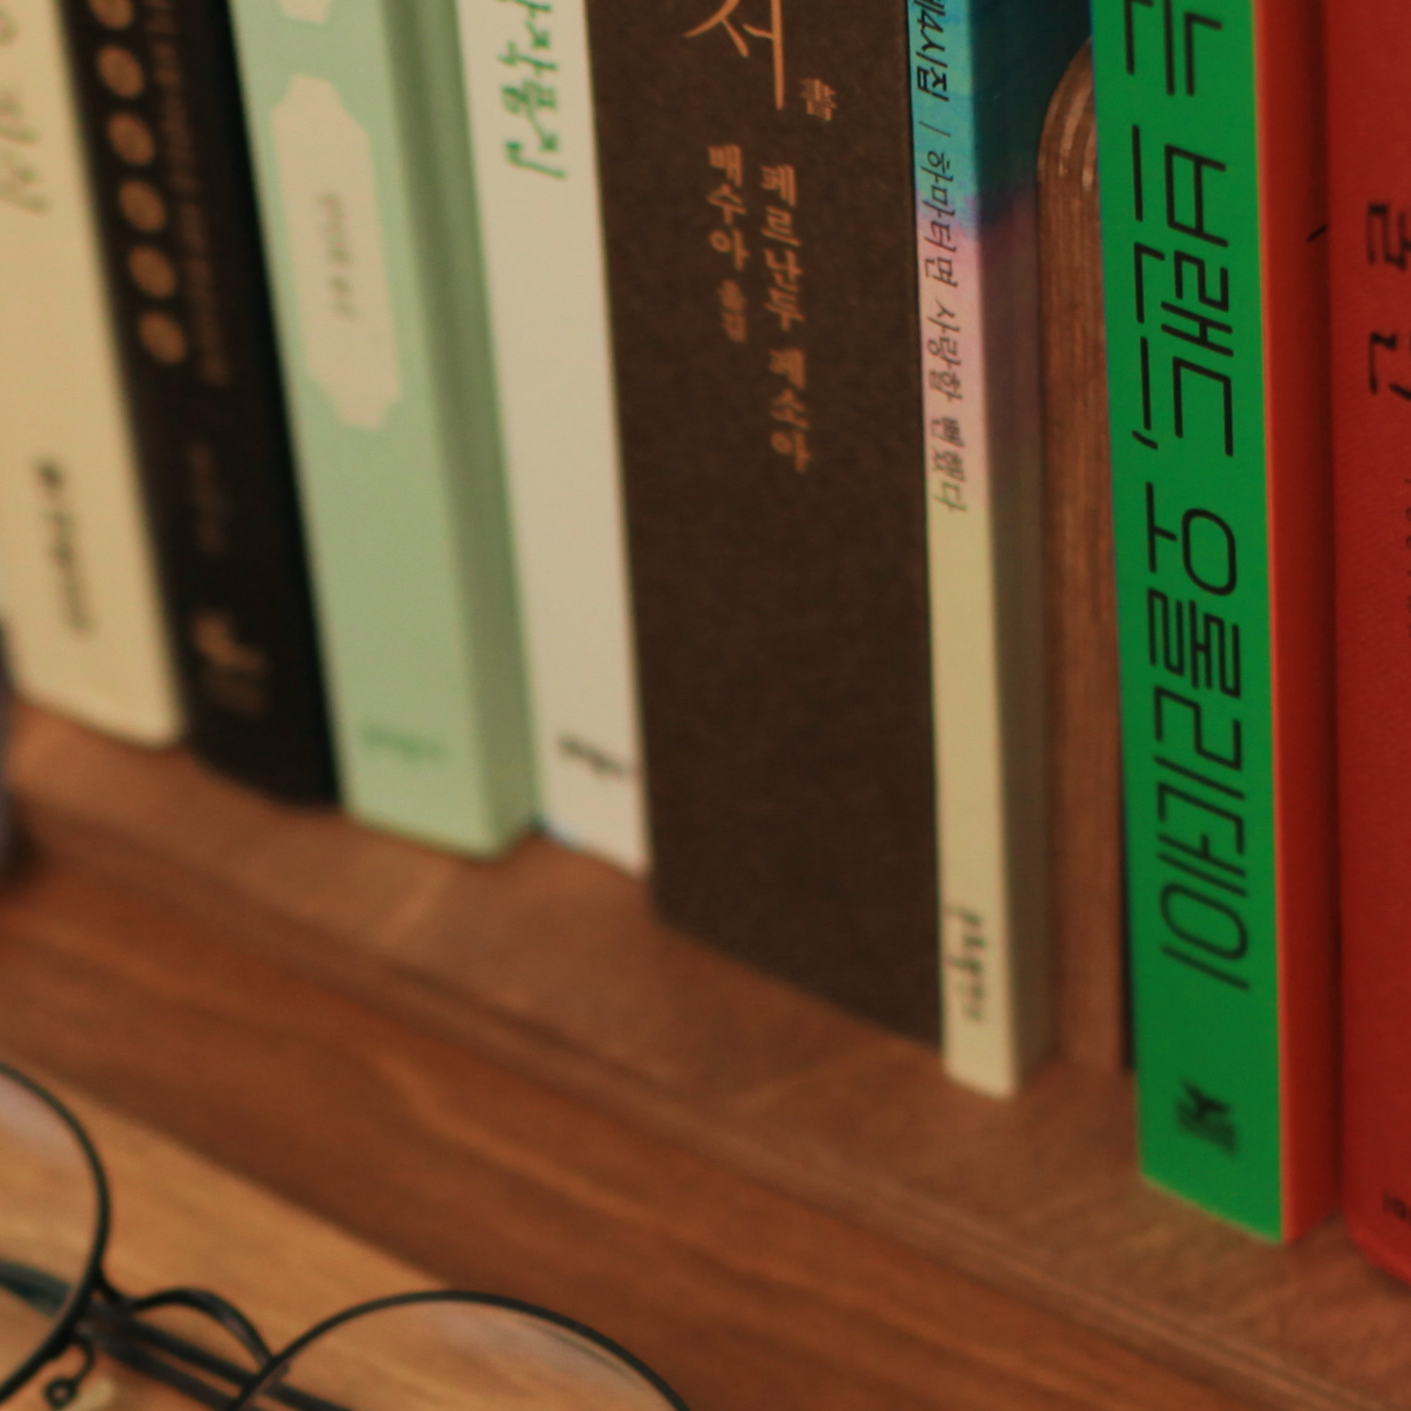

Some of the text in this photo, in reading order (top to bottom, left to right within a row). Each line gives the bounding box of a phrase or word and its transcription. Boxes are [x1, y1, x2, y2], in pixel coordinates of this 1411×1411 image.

[919, 149, 960, 288] 하마터면
[926, 296, 963, 404] 사랑할
[1130, 124, 1235, 455] 브랜드,
[931, 416, 969, 515] 뻔했다
[1145, 481, 1251, 993] 오롤리데이
